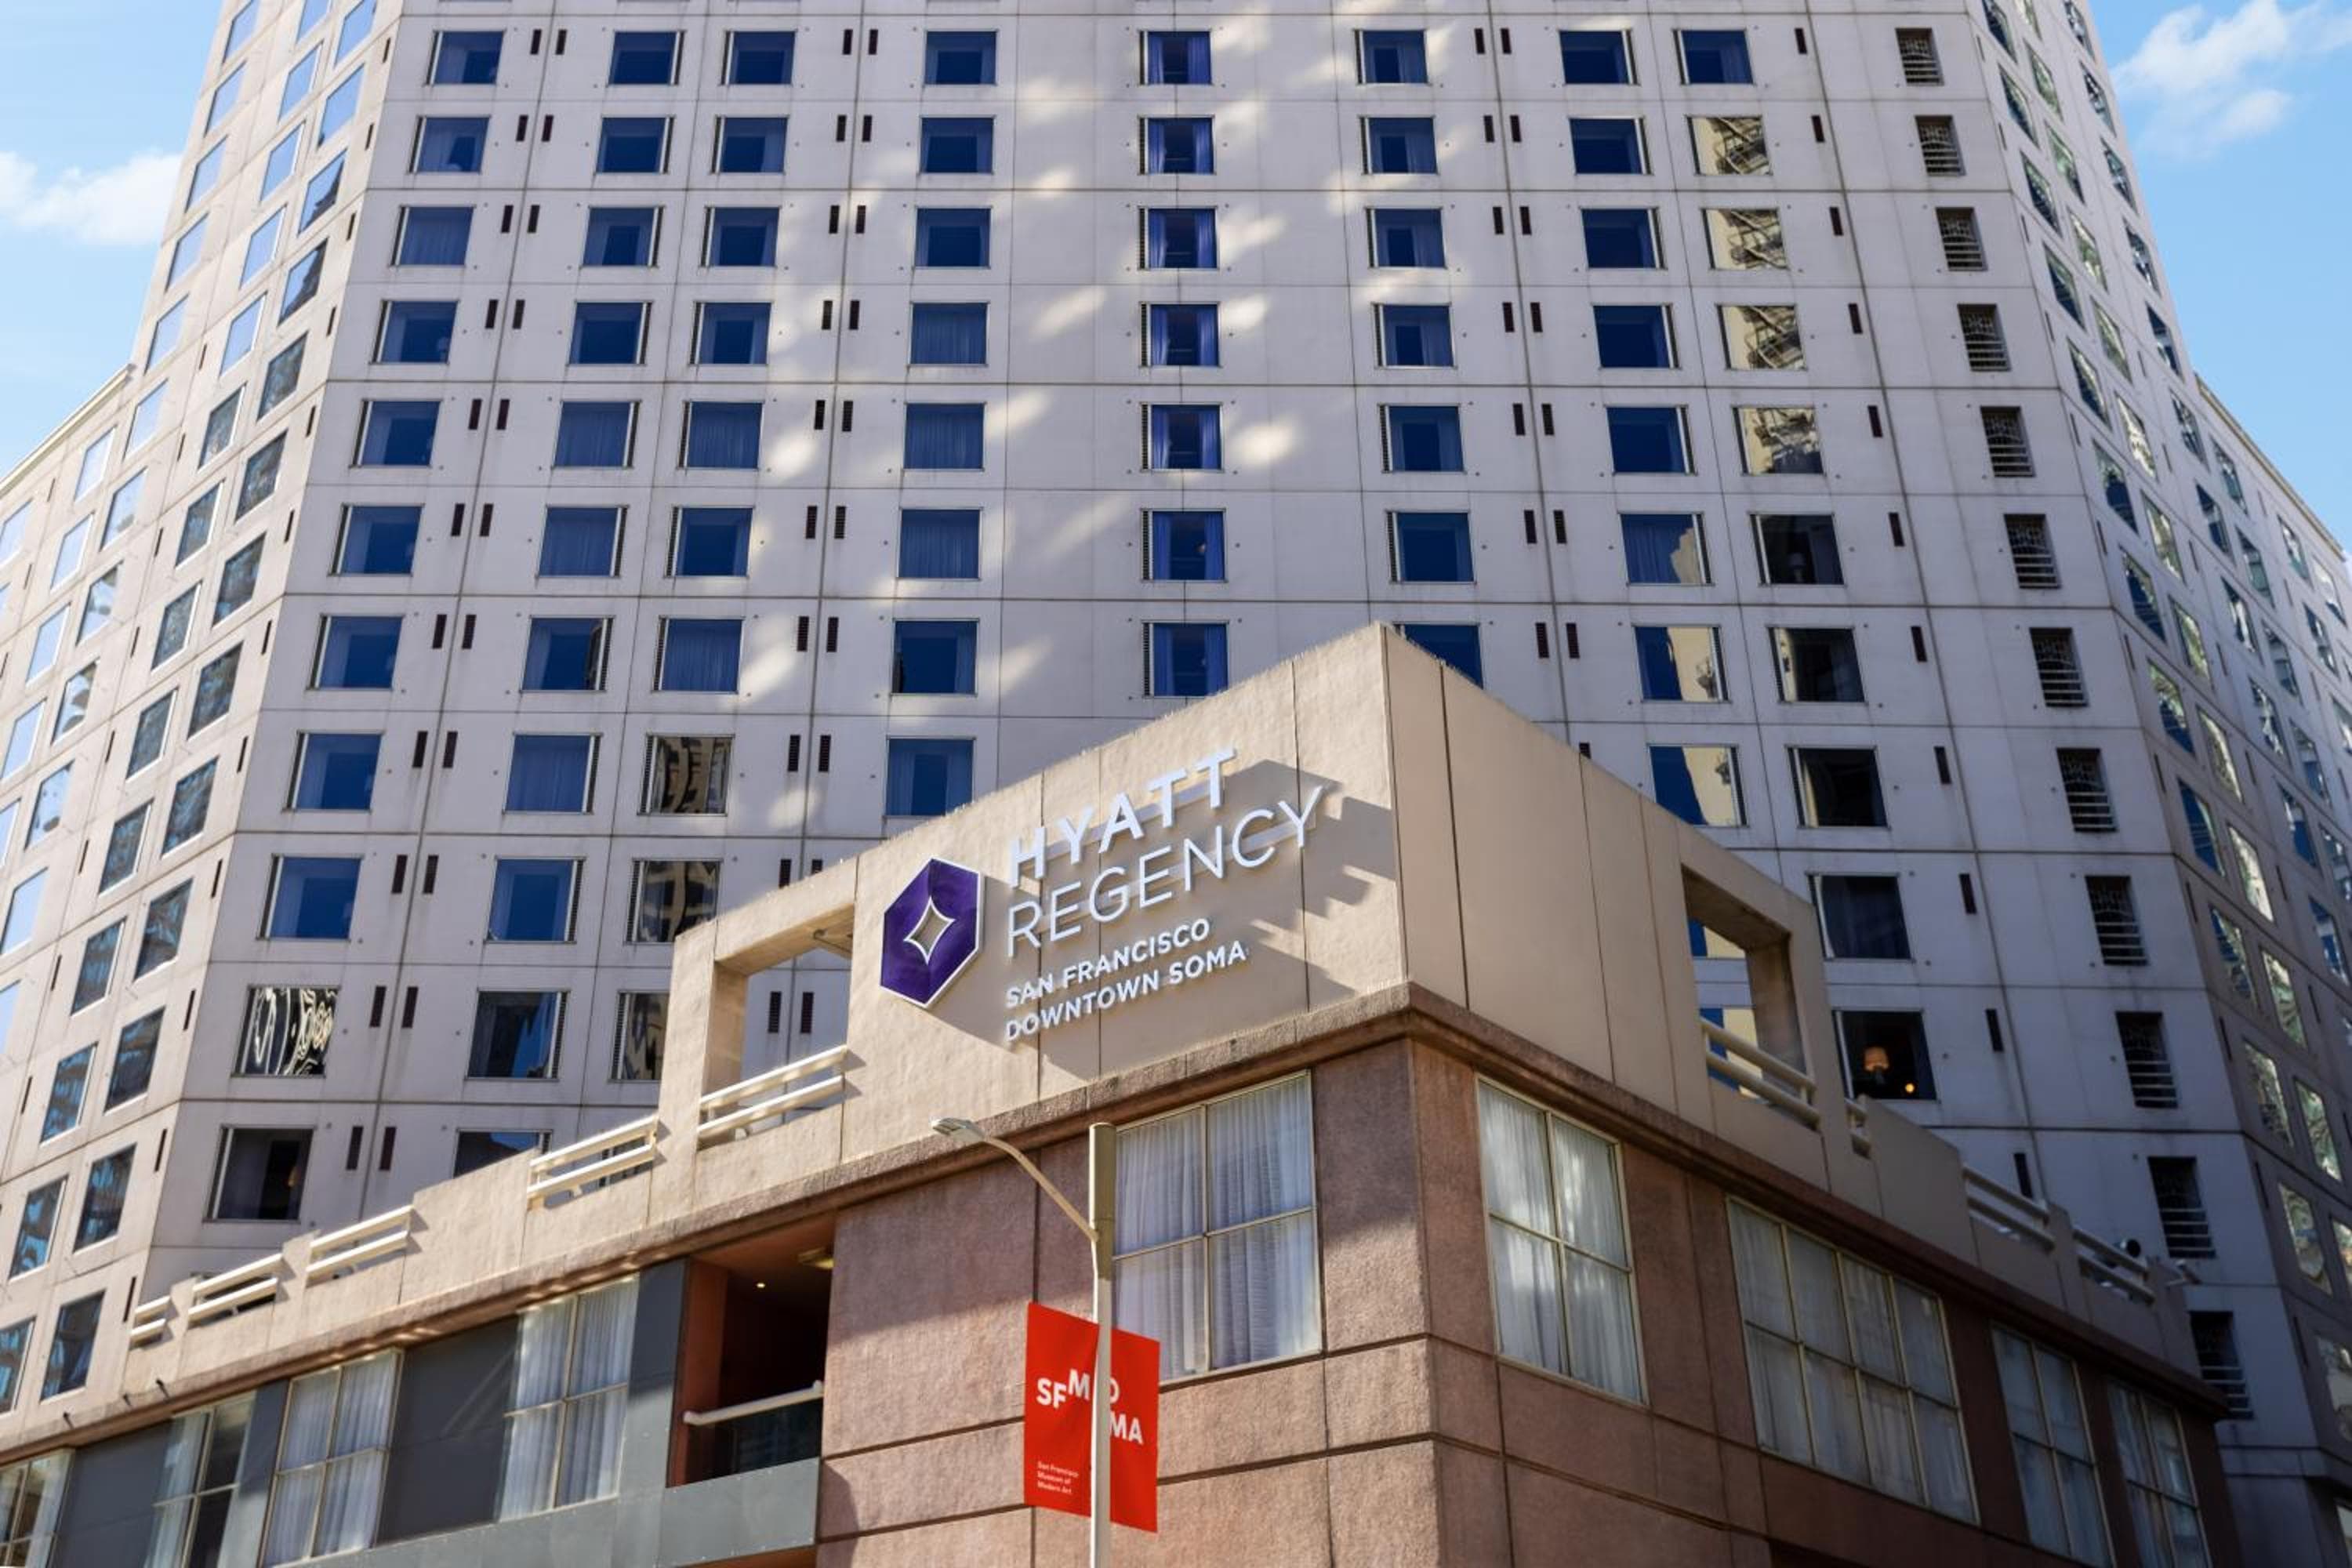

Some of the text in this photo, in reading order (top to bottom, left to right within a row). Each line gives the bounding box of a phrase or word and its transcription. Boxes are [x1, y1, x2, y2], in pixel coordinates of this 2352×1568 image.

[1007, 747, 1237, 889] HYATT
[1007, 785, 1325, 957] REGENCY
[1004, 940, 1247, 1042] DOWNTOWN SOMA
[1005, 917, 1210, 1009] SAN FRANCISCO
